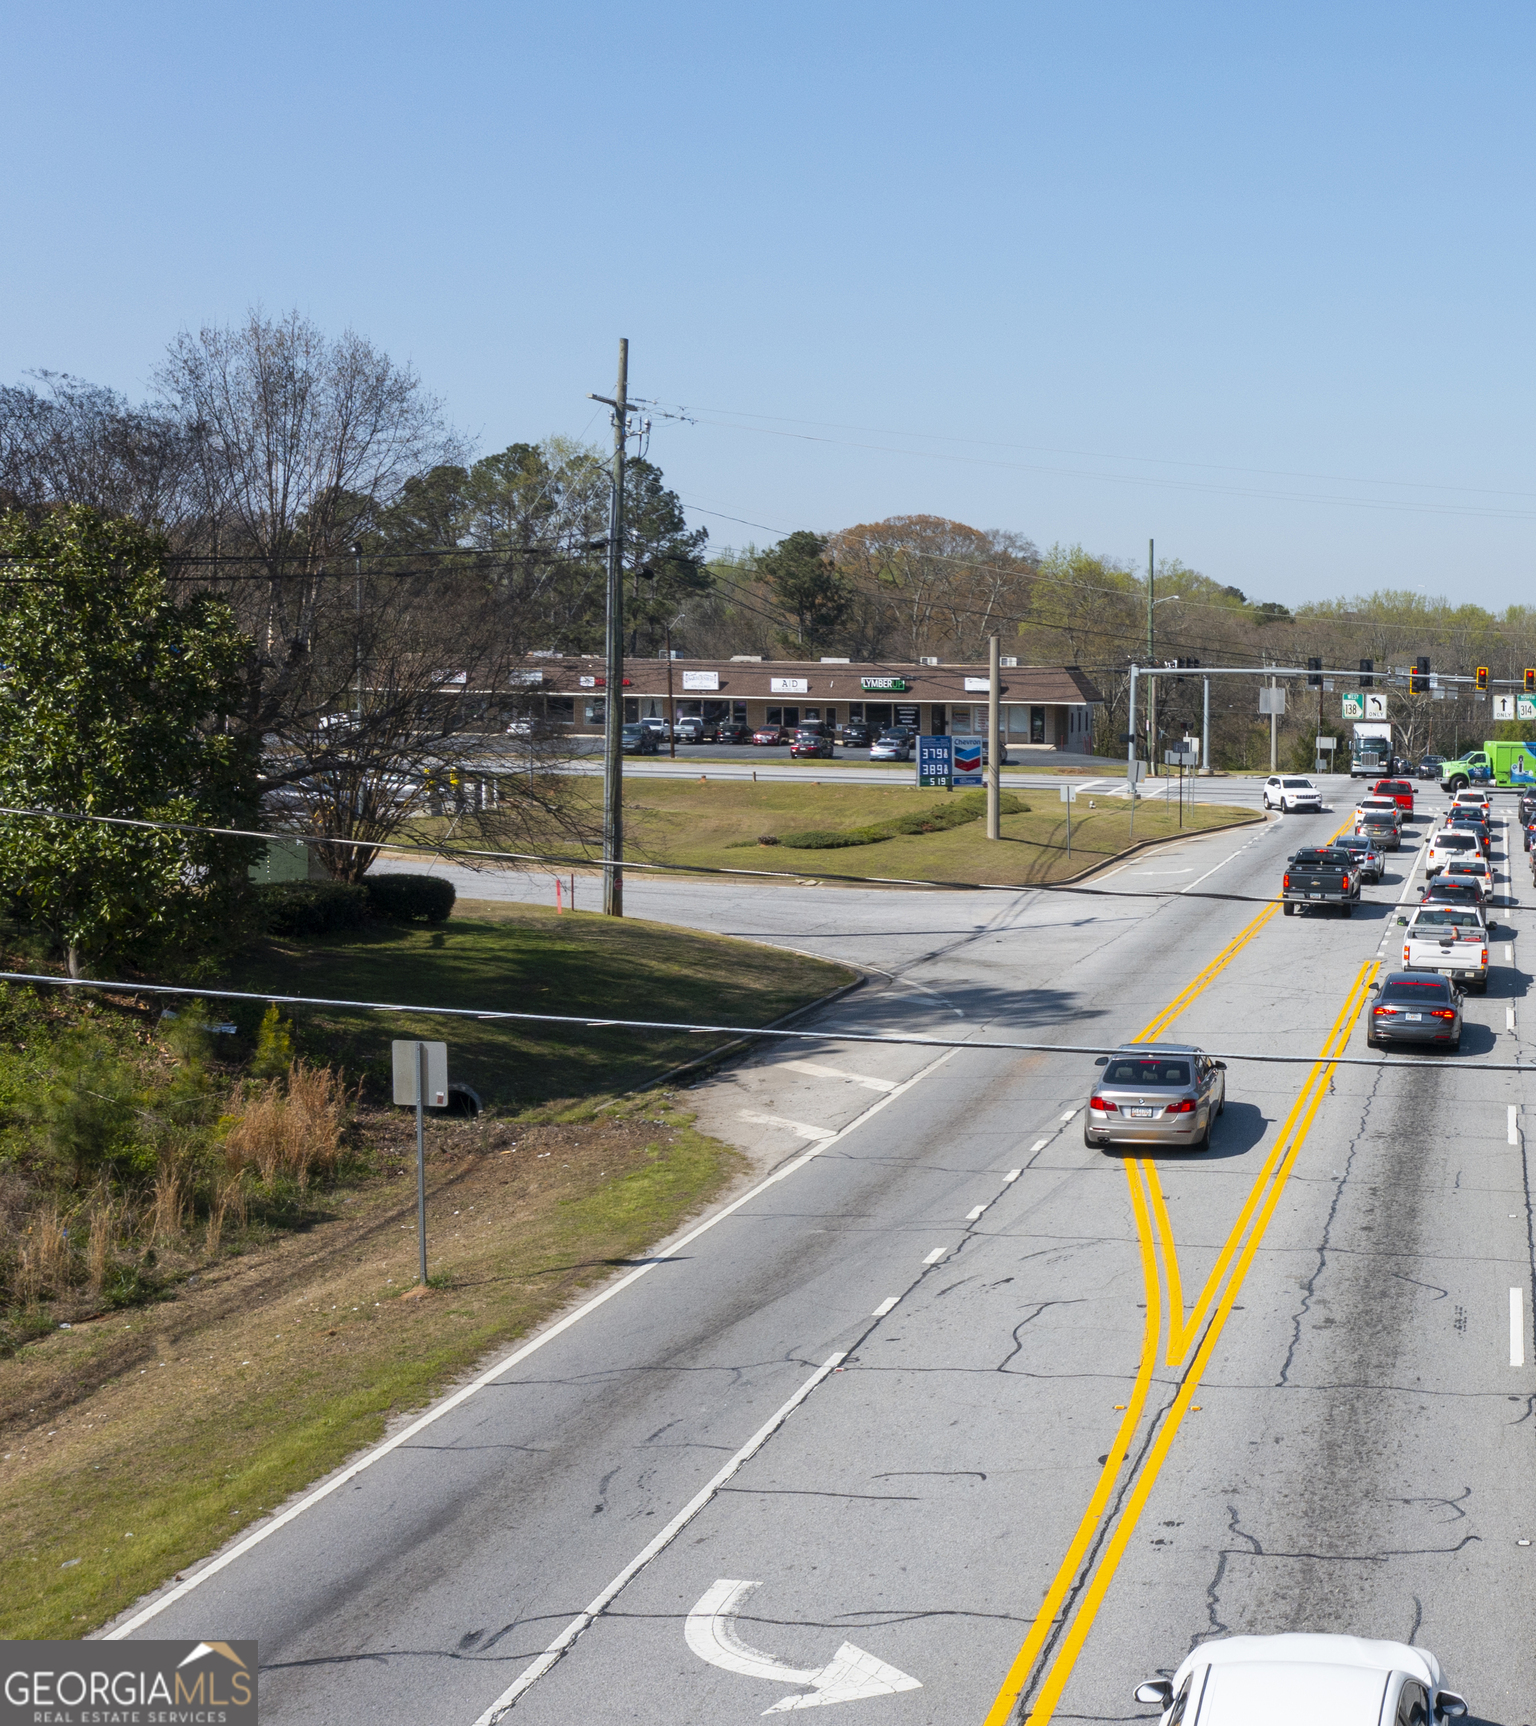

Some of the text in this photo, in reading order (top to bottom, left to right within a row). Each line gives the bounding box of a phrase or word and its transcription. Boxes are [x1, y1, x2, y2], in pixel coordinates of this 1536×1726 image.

[863, 679, 904, 688] LYMBERUP
[1345, 704, 1357, 714] 138
[1520, 705, 1532, 716] 314
